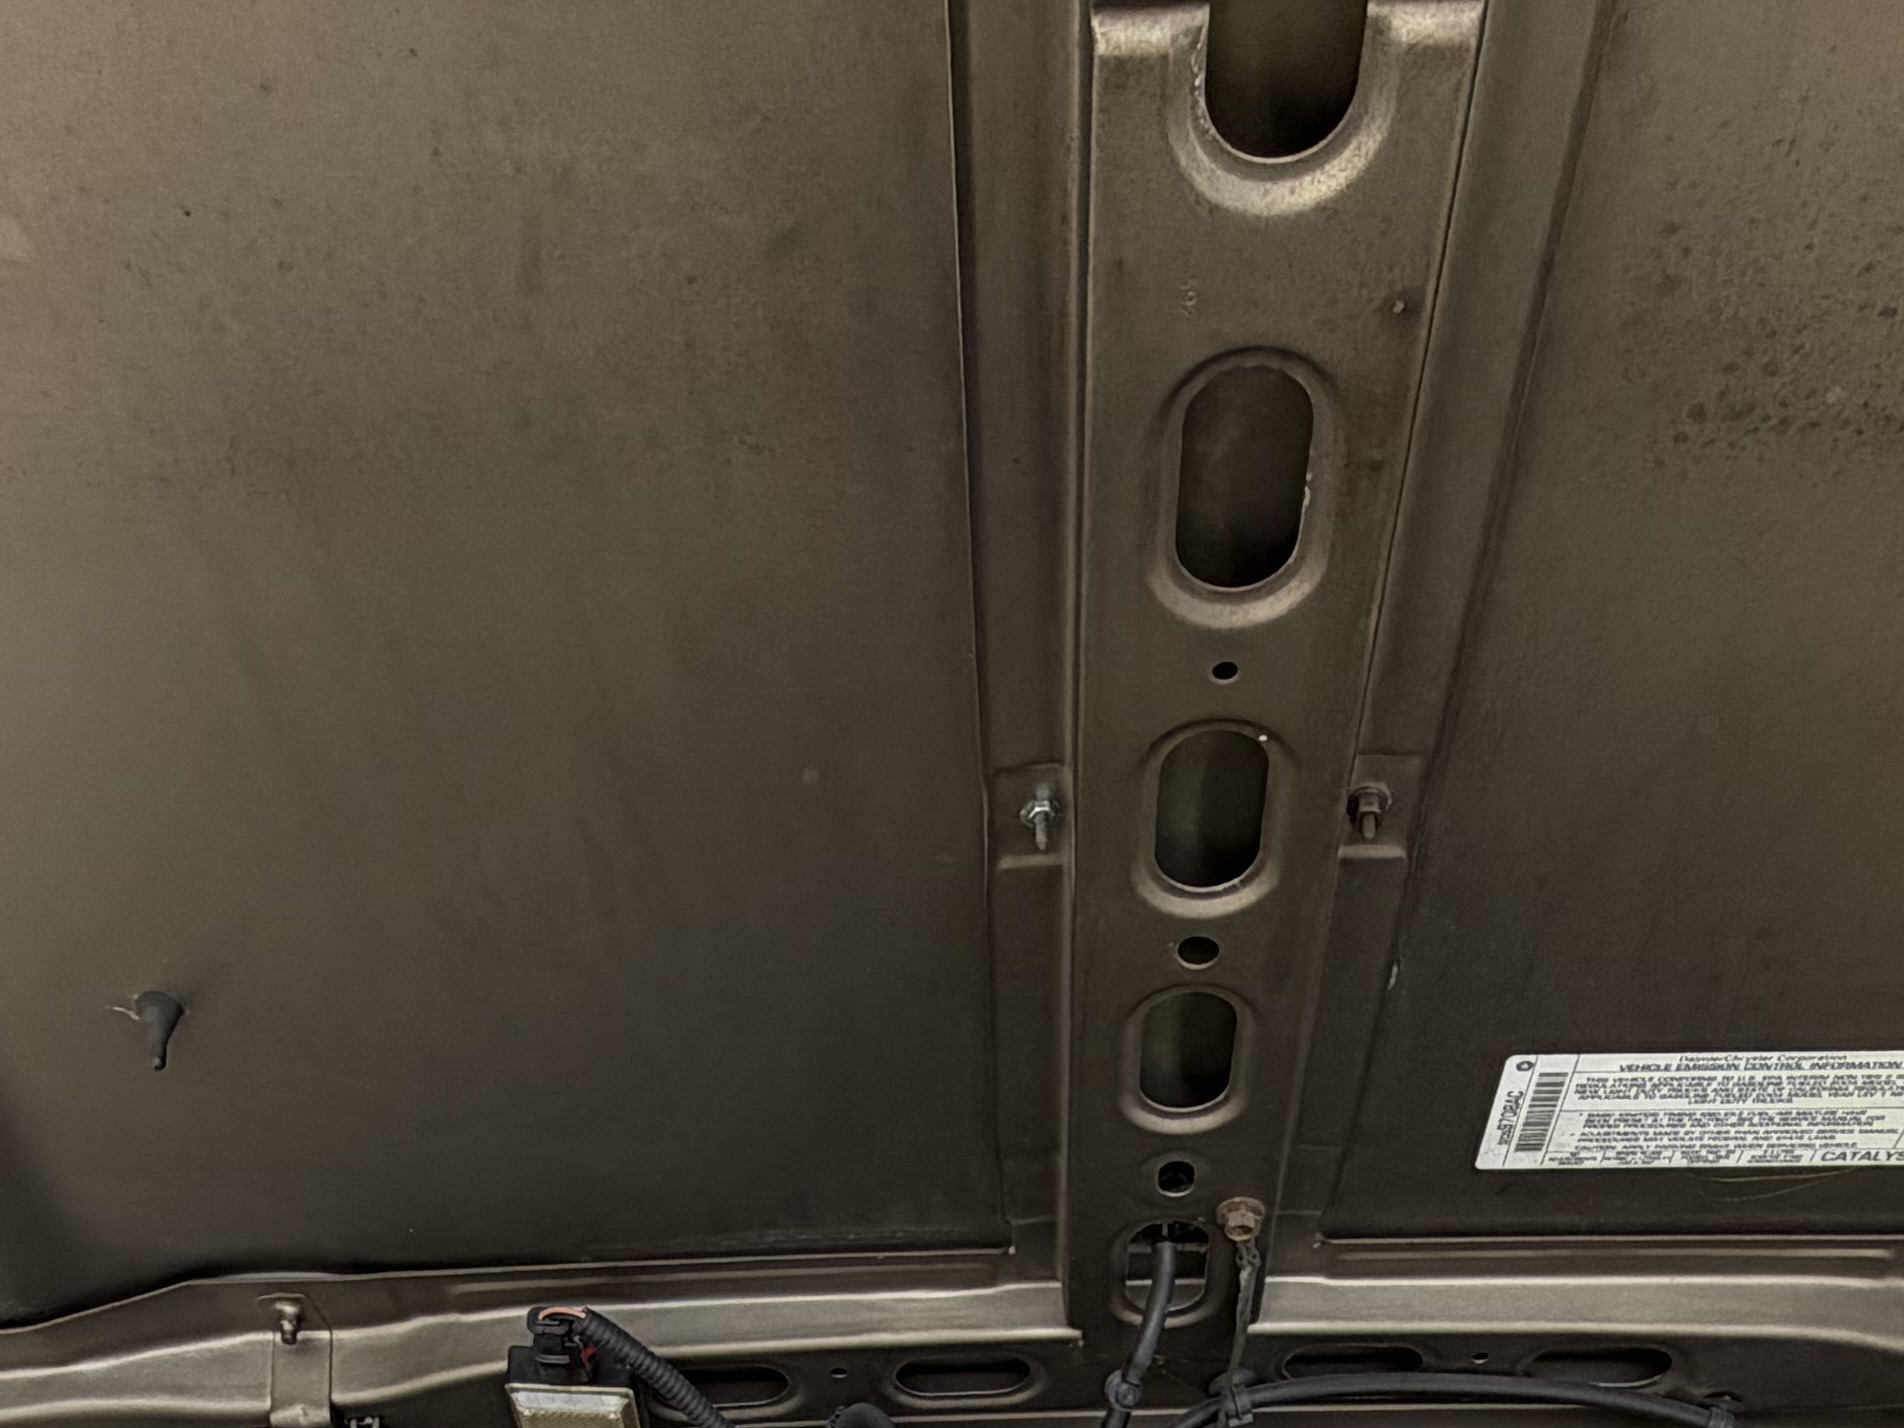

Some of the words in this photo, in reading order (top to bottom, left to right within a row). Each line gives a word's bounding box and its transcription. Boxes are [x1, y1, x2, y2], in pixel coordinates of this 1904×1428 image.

[1619, 1064, 1672, 1072] VEHICLE
[1675, 1063, 1741, 1071] EMISSION
[1809, 1061, 1903, 1070] INFORMATION
